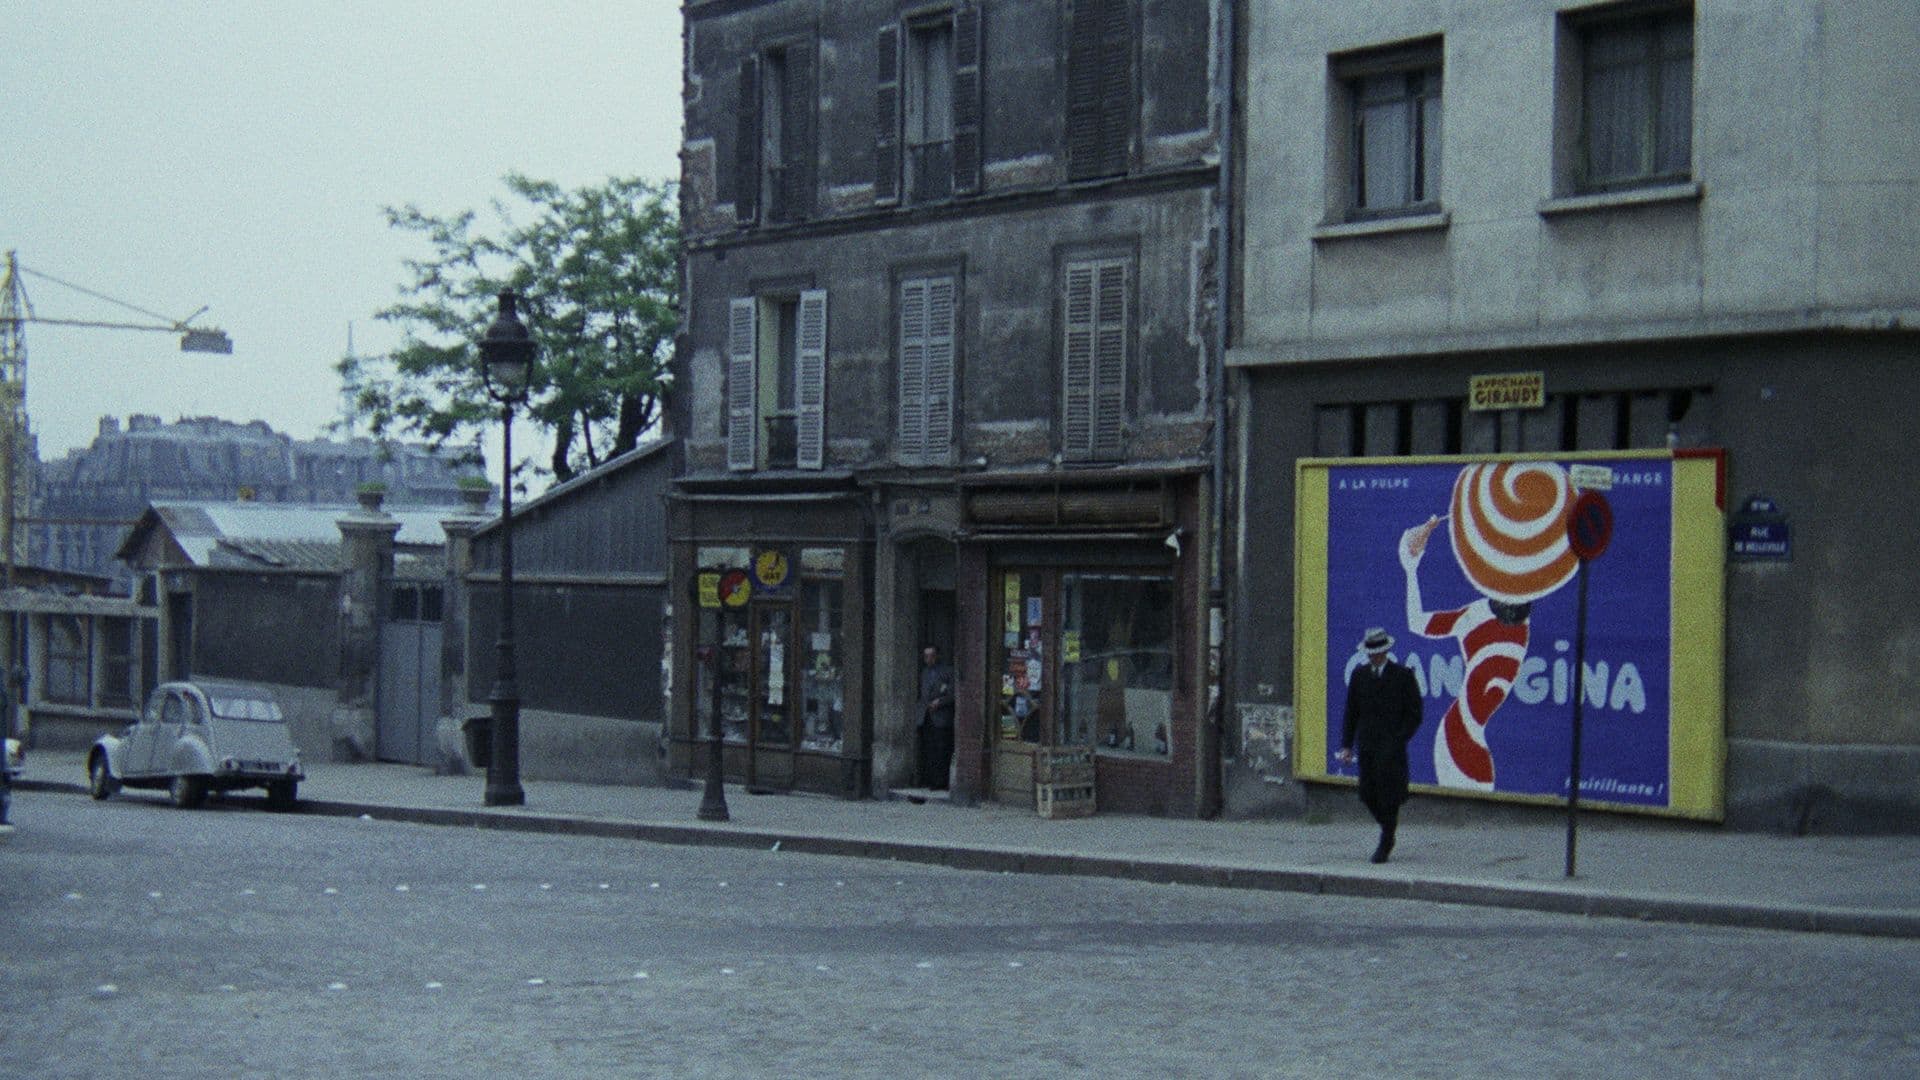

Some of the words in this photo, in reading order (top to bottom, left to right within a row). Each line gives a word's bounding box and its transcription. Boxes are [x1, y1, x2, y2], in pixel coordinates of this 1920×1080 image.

[1475, 387, 1540, 405] GIRAUDY
[1339, 478, 1348, 489] A
[1351, 478, 1366, 490] LA
[1371, 478, 1409, 489] PULPE
[1612, 472, 1663, 486] RANGE
